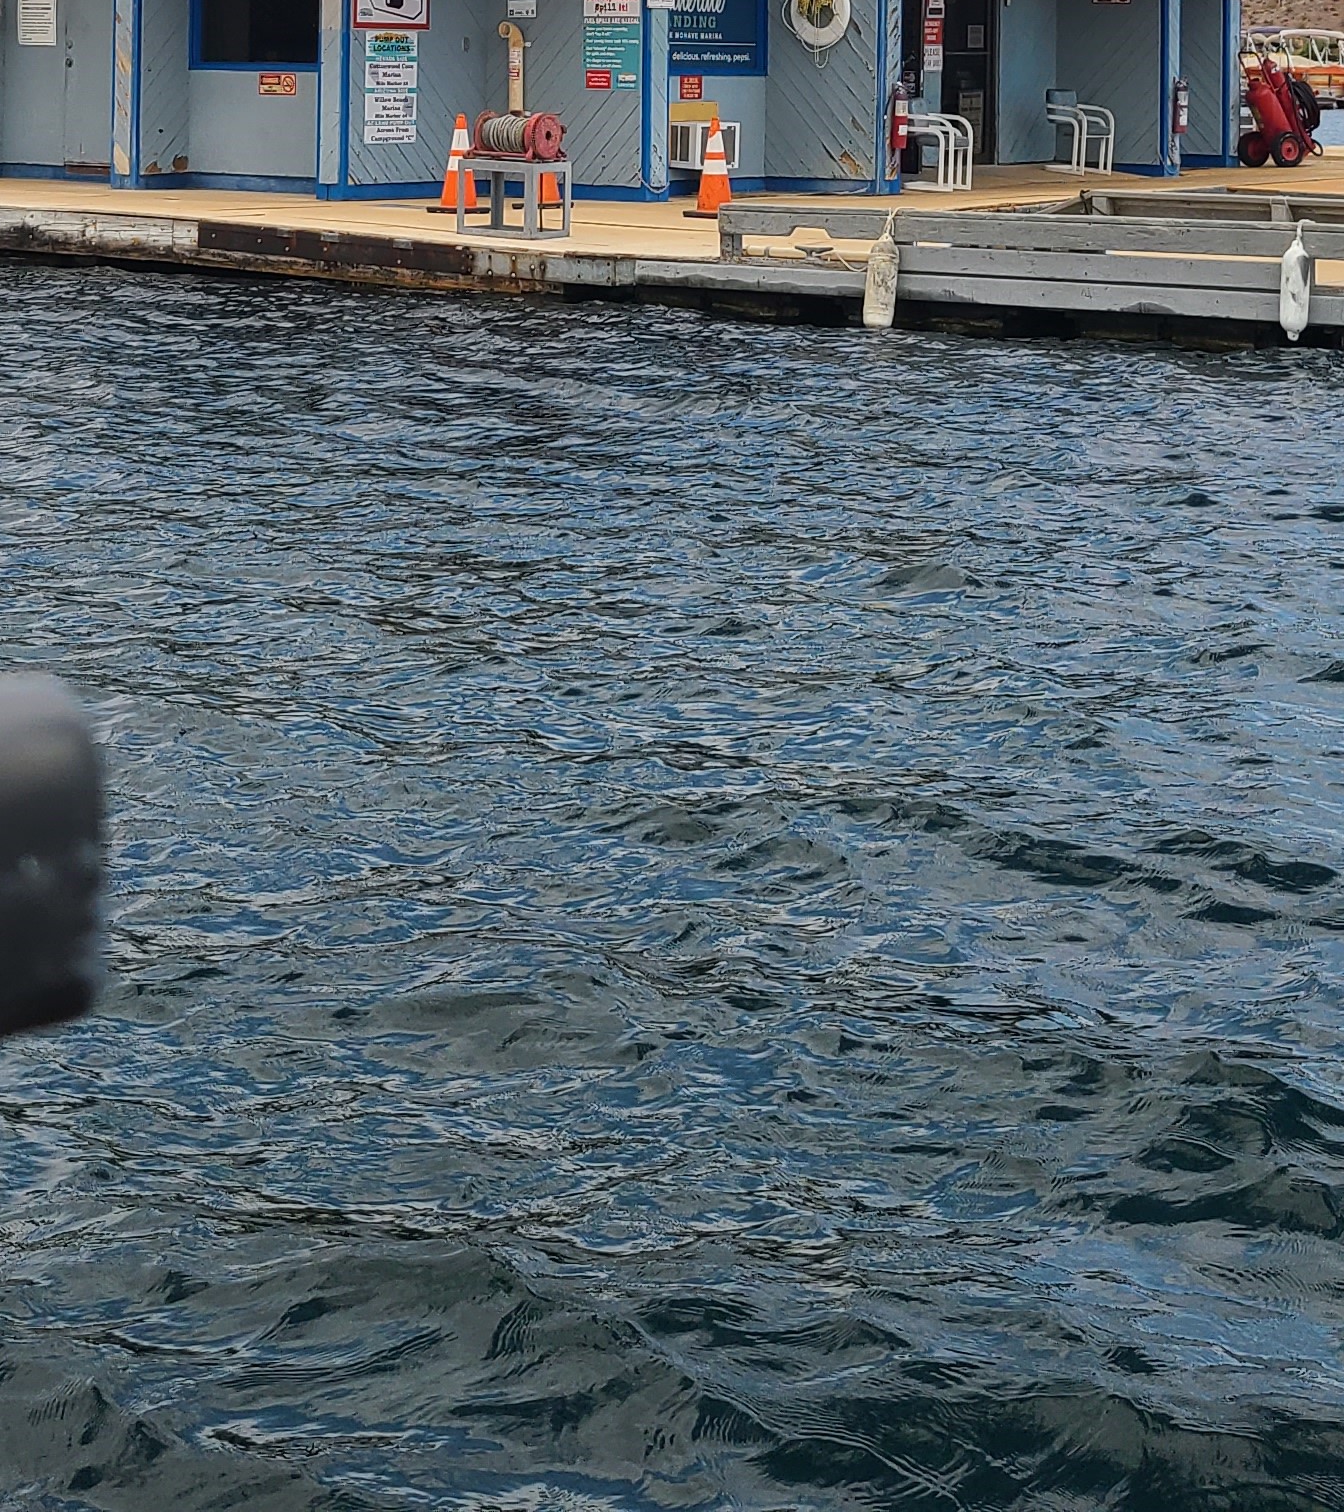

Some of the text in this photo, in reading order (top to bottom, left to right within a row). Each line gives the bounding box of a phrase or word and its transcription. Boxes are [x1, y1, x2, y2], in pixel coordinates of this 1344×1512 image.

[670, 15, 716, 28] NDING
[395, 36, 409, 44] OUT
[373, 44, 410, 52] LOCATIONS
